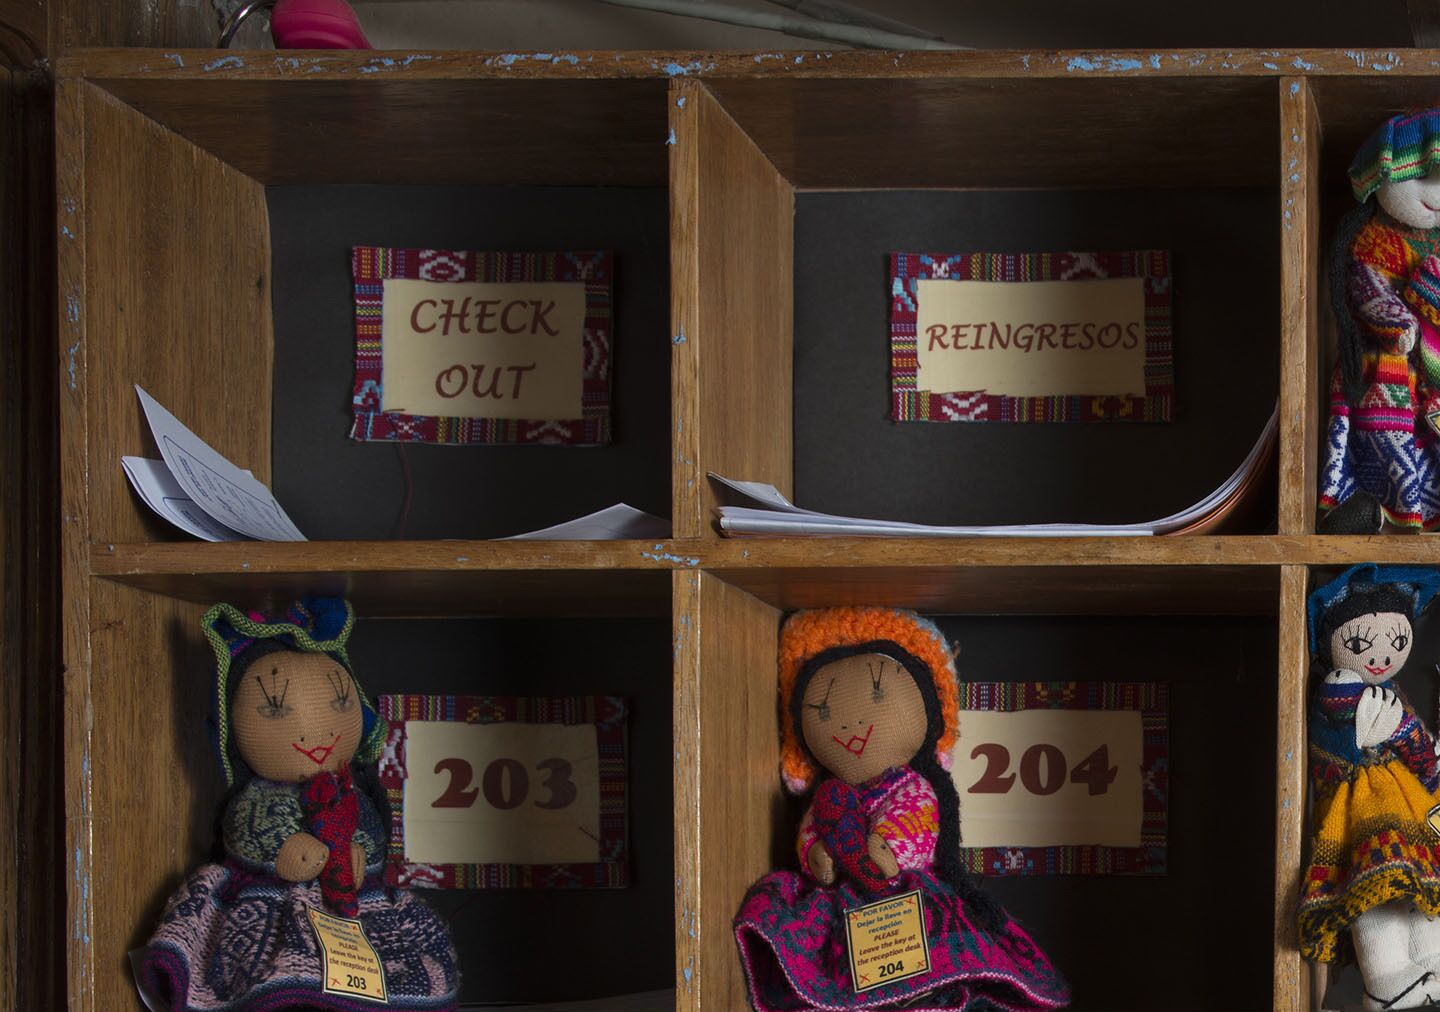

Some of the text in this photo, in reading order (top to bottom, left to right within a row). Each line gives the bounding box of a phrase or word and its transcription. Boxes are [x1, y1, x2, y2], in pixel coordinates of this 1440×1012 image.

[410, 297, 560, 336] CHECK
[925, 322, 1139, 352] REINGRESOS
[435, 362, 536, 399] OUT
[967, 743, 1118, 796] 204
[431, 758, 577, 810] 203
[863, 901, 903, 917] POR FAVOR
[857, 919, 875, 928] Dejar
[885, 912, 901, 920] llave
[869, 921, 903, 934] recepción
[874, 929, 899, 941] PLEASE
[338, 942, 358, 950] PLEASE
[859, 945, 879, 955] Leave
[881, 941, 893, 949] the
[894, 937, 906, 946] key
[330, 948, 346, 956] Leave
[358, 955, 368, 963] key
[857, 943, 921, 966] the reception desk
[340, 961, 365, 971] reception
[367, 966, 378, 974] desk
[879, 961, 904, 977] 204
[347, 975, 366, 990] 203
